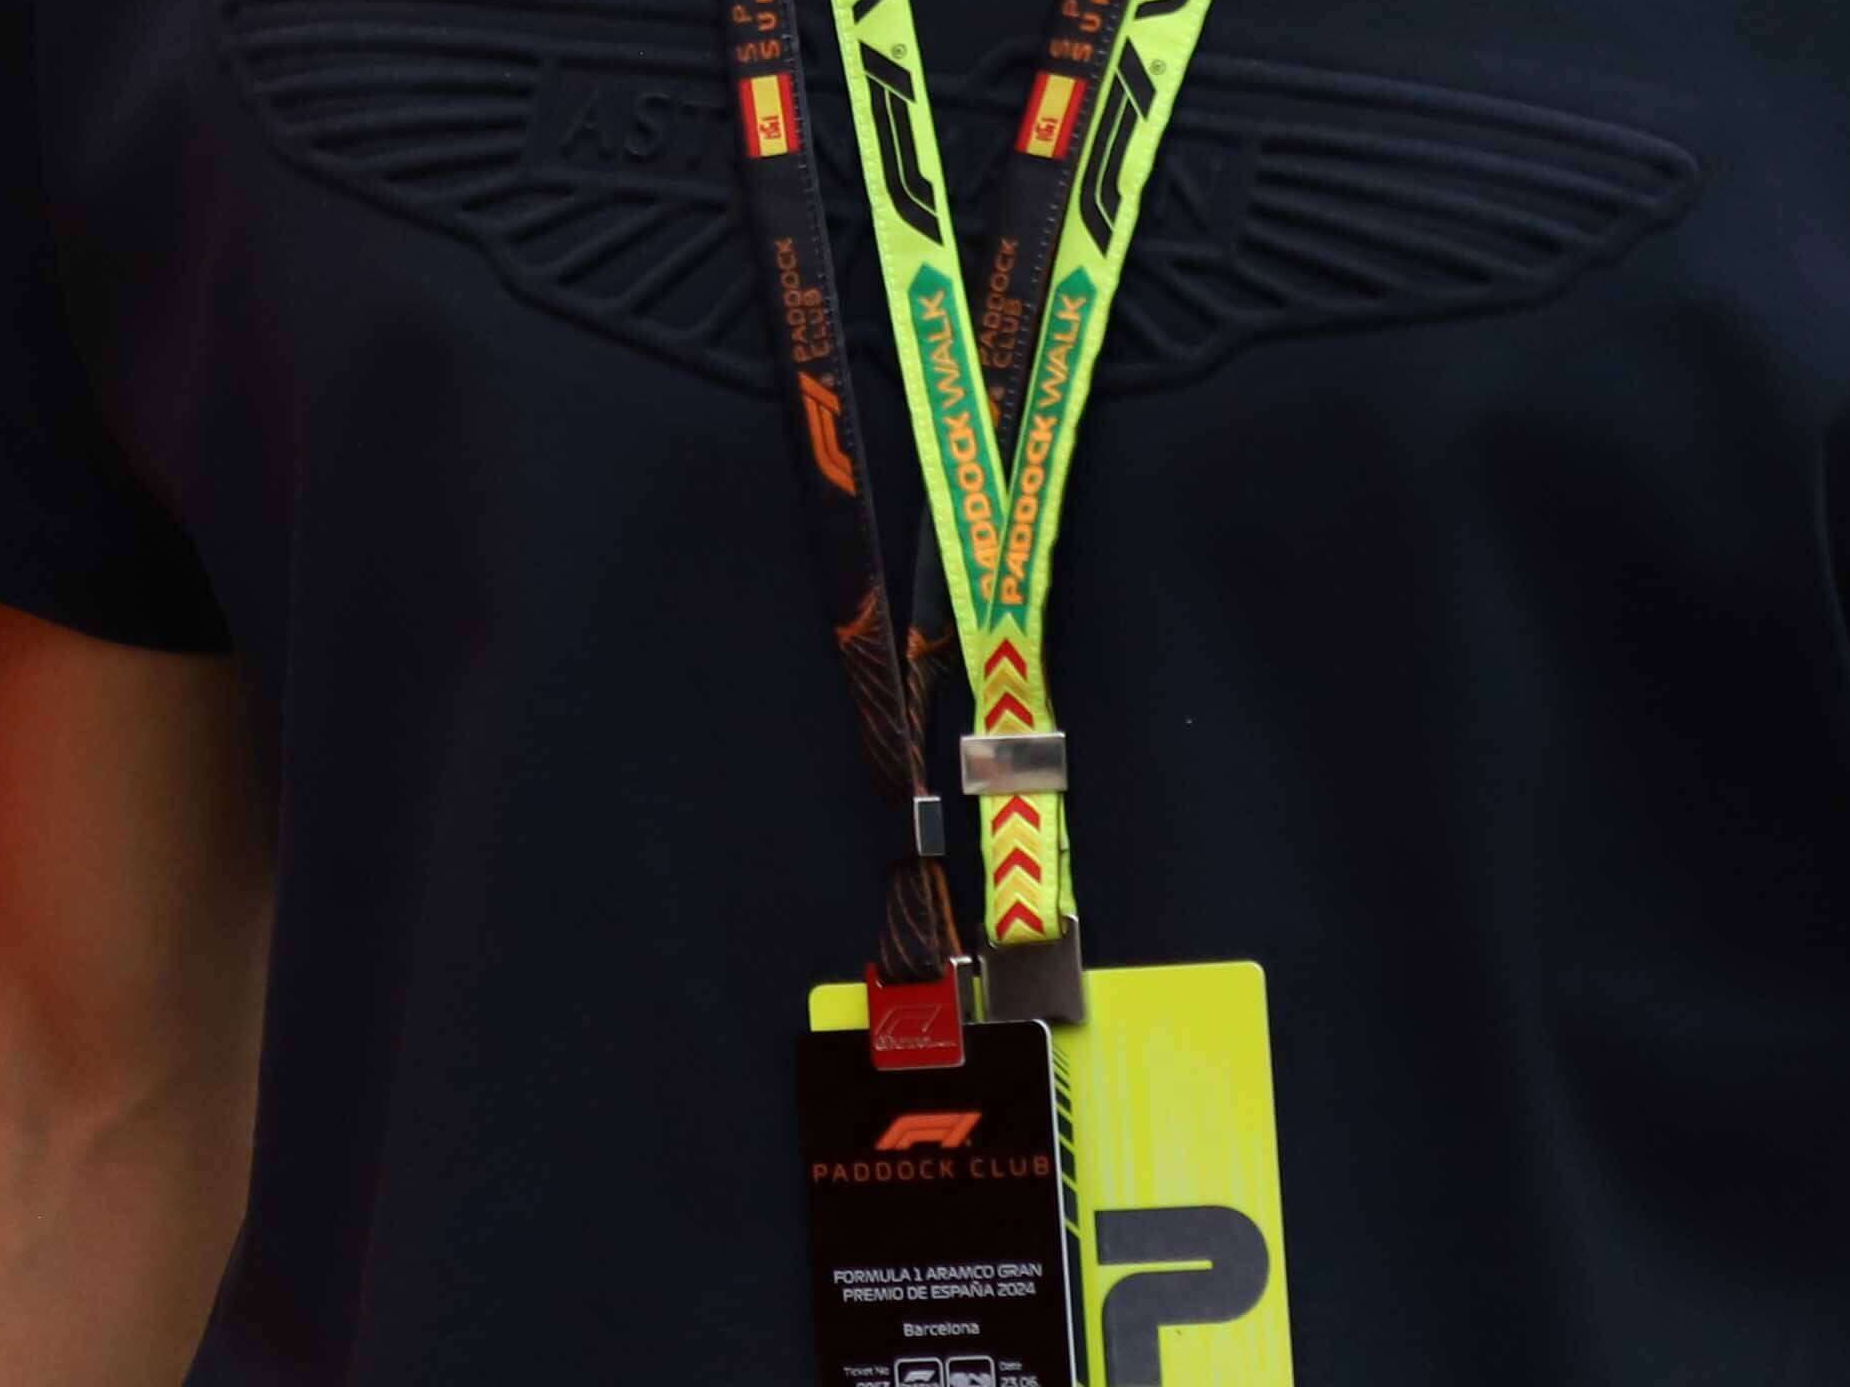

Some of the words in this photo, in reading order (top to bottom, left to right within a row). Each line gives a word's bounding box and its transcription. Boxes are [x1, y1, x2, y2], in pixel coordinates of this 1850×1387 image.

[774, 238, 814, 363] PADDOCK
[802, 288, 832, 359] CLUB
[992, 298, 1022, 368] CLUB
[919, 289, 965, 409] WALK
[1000, 414, 1057, 605] PADDOCK
[1039, 293, 1088, 407] WALK
[812, 1159, 956, 1183] PADDOCK
[969, 1156, 1050, 1179] CLUB
[833, 1268, 912, 1284] FORMULA
[913, 1266, 924, 1282] 1
[925, 1265, 995, 1281] ARAMCO
[997, 1263, 1043, 1278] GRAN
[843, 1287, 904, 1303] PREMIO
[907, 1285, 928, 1300] DE
[931, 1281, 995, 1300] ESPAÑA
[997, 1282, 1037, 1297] 2024
[903, 1322, 981, 1338] Barcelona
